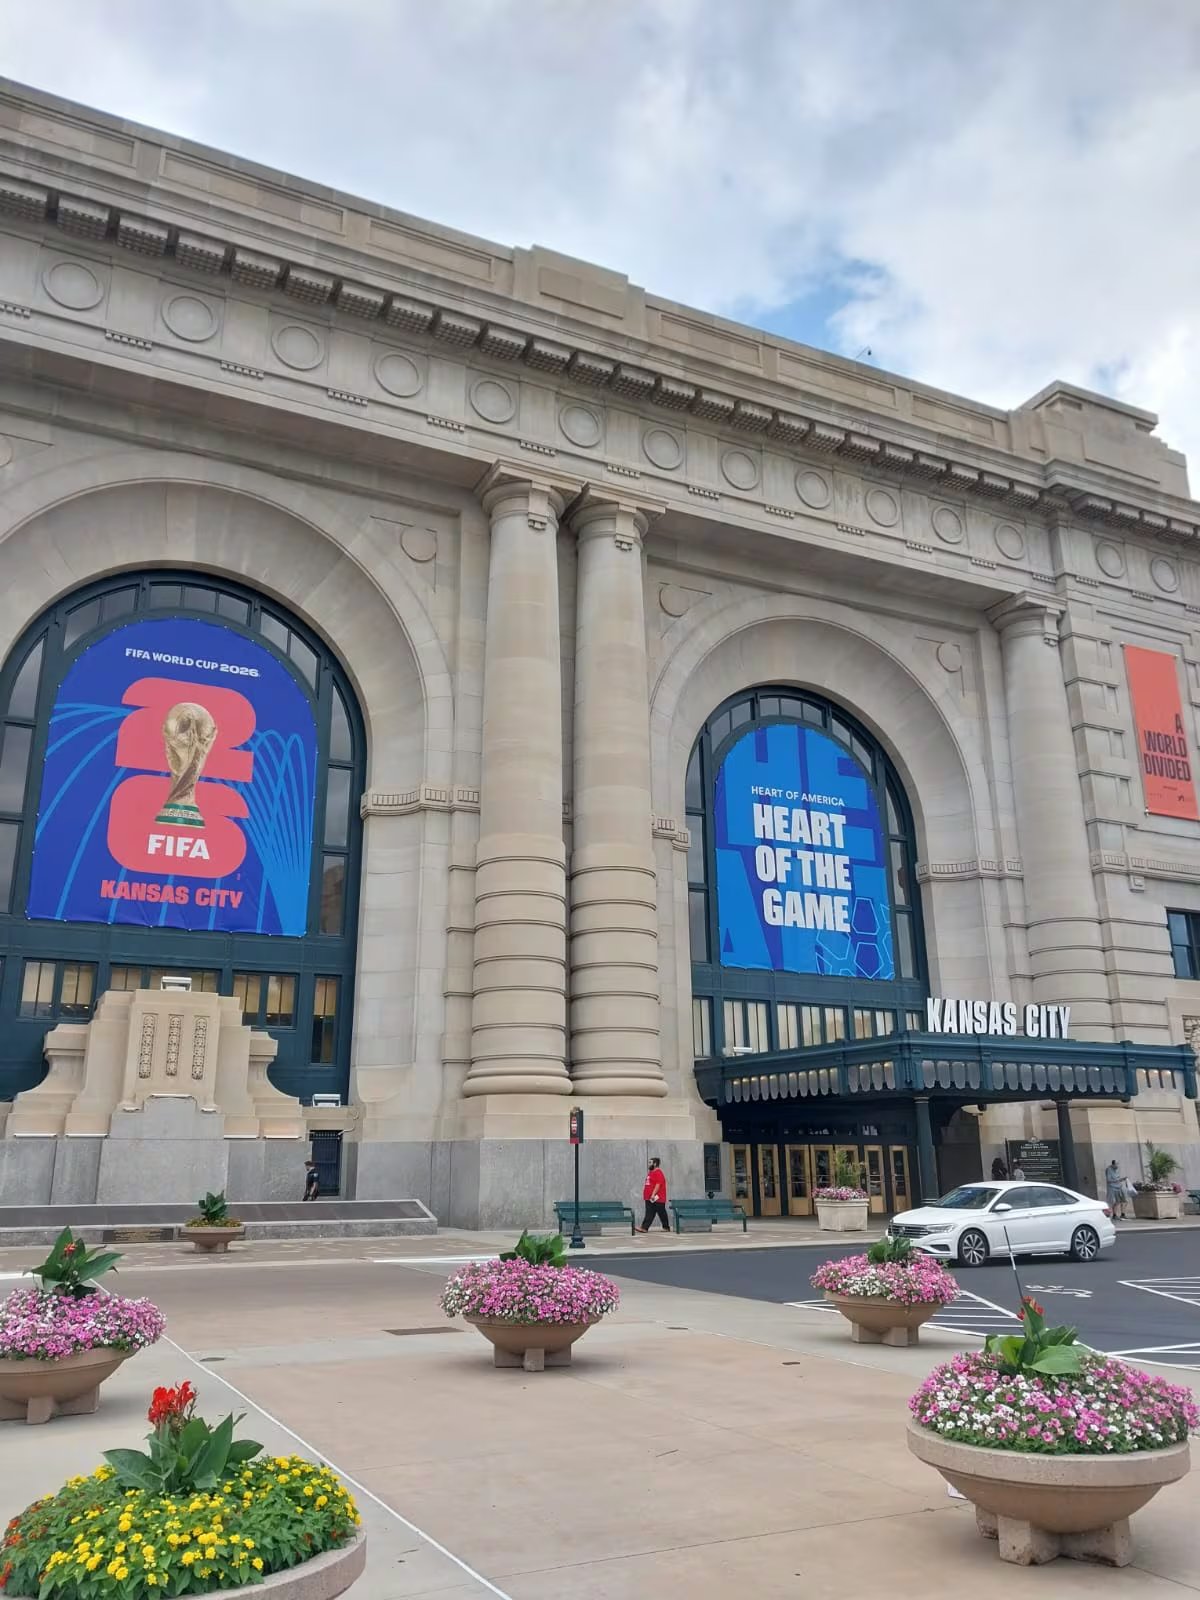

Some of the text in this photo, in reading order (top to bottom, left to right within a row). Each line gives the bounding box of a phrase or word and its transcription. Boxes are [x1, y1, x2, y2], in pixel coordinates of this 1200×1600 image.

[125, 647, 259, 677] FIFA WORLD CUP 2026
[1174, 713, 1184, 735] A
[1143, 729, 1188, 758] WORLD
[1143, 752, 1191, 782] DIVIDED
[751, 786, 845, 807] HEART OF AMERICA
[752, 802, 846, 849] HEART
[147, 834, 210, 860] FIFA
[755, 845, 852, 891] OF THE
[100, 879, 243, 909] KANSAS CITY
[762, 888, 851, 933] GAME
[926, 997, 1070, 1039] KANSAS CITY
